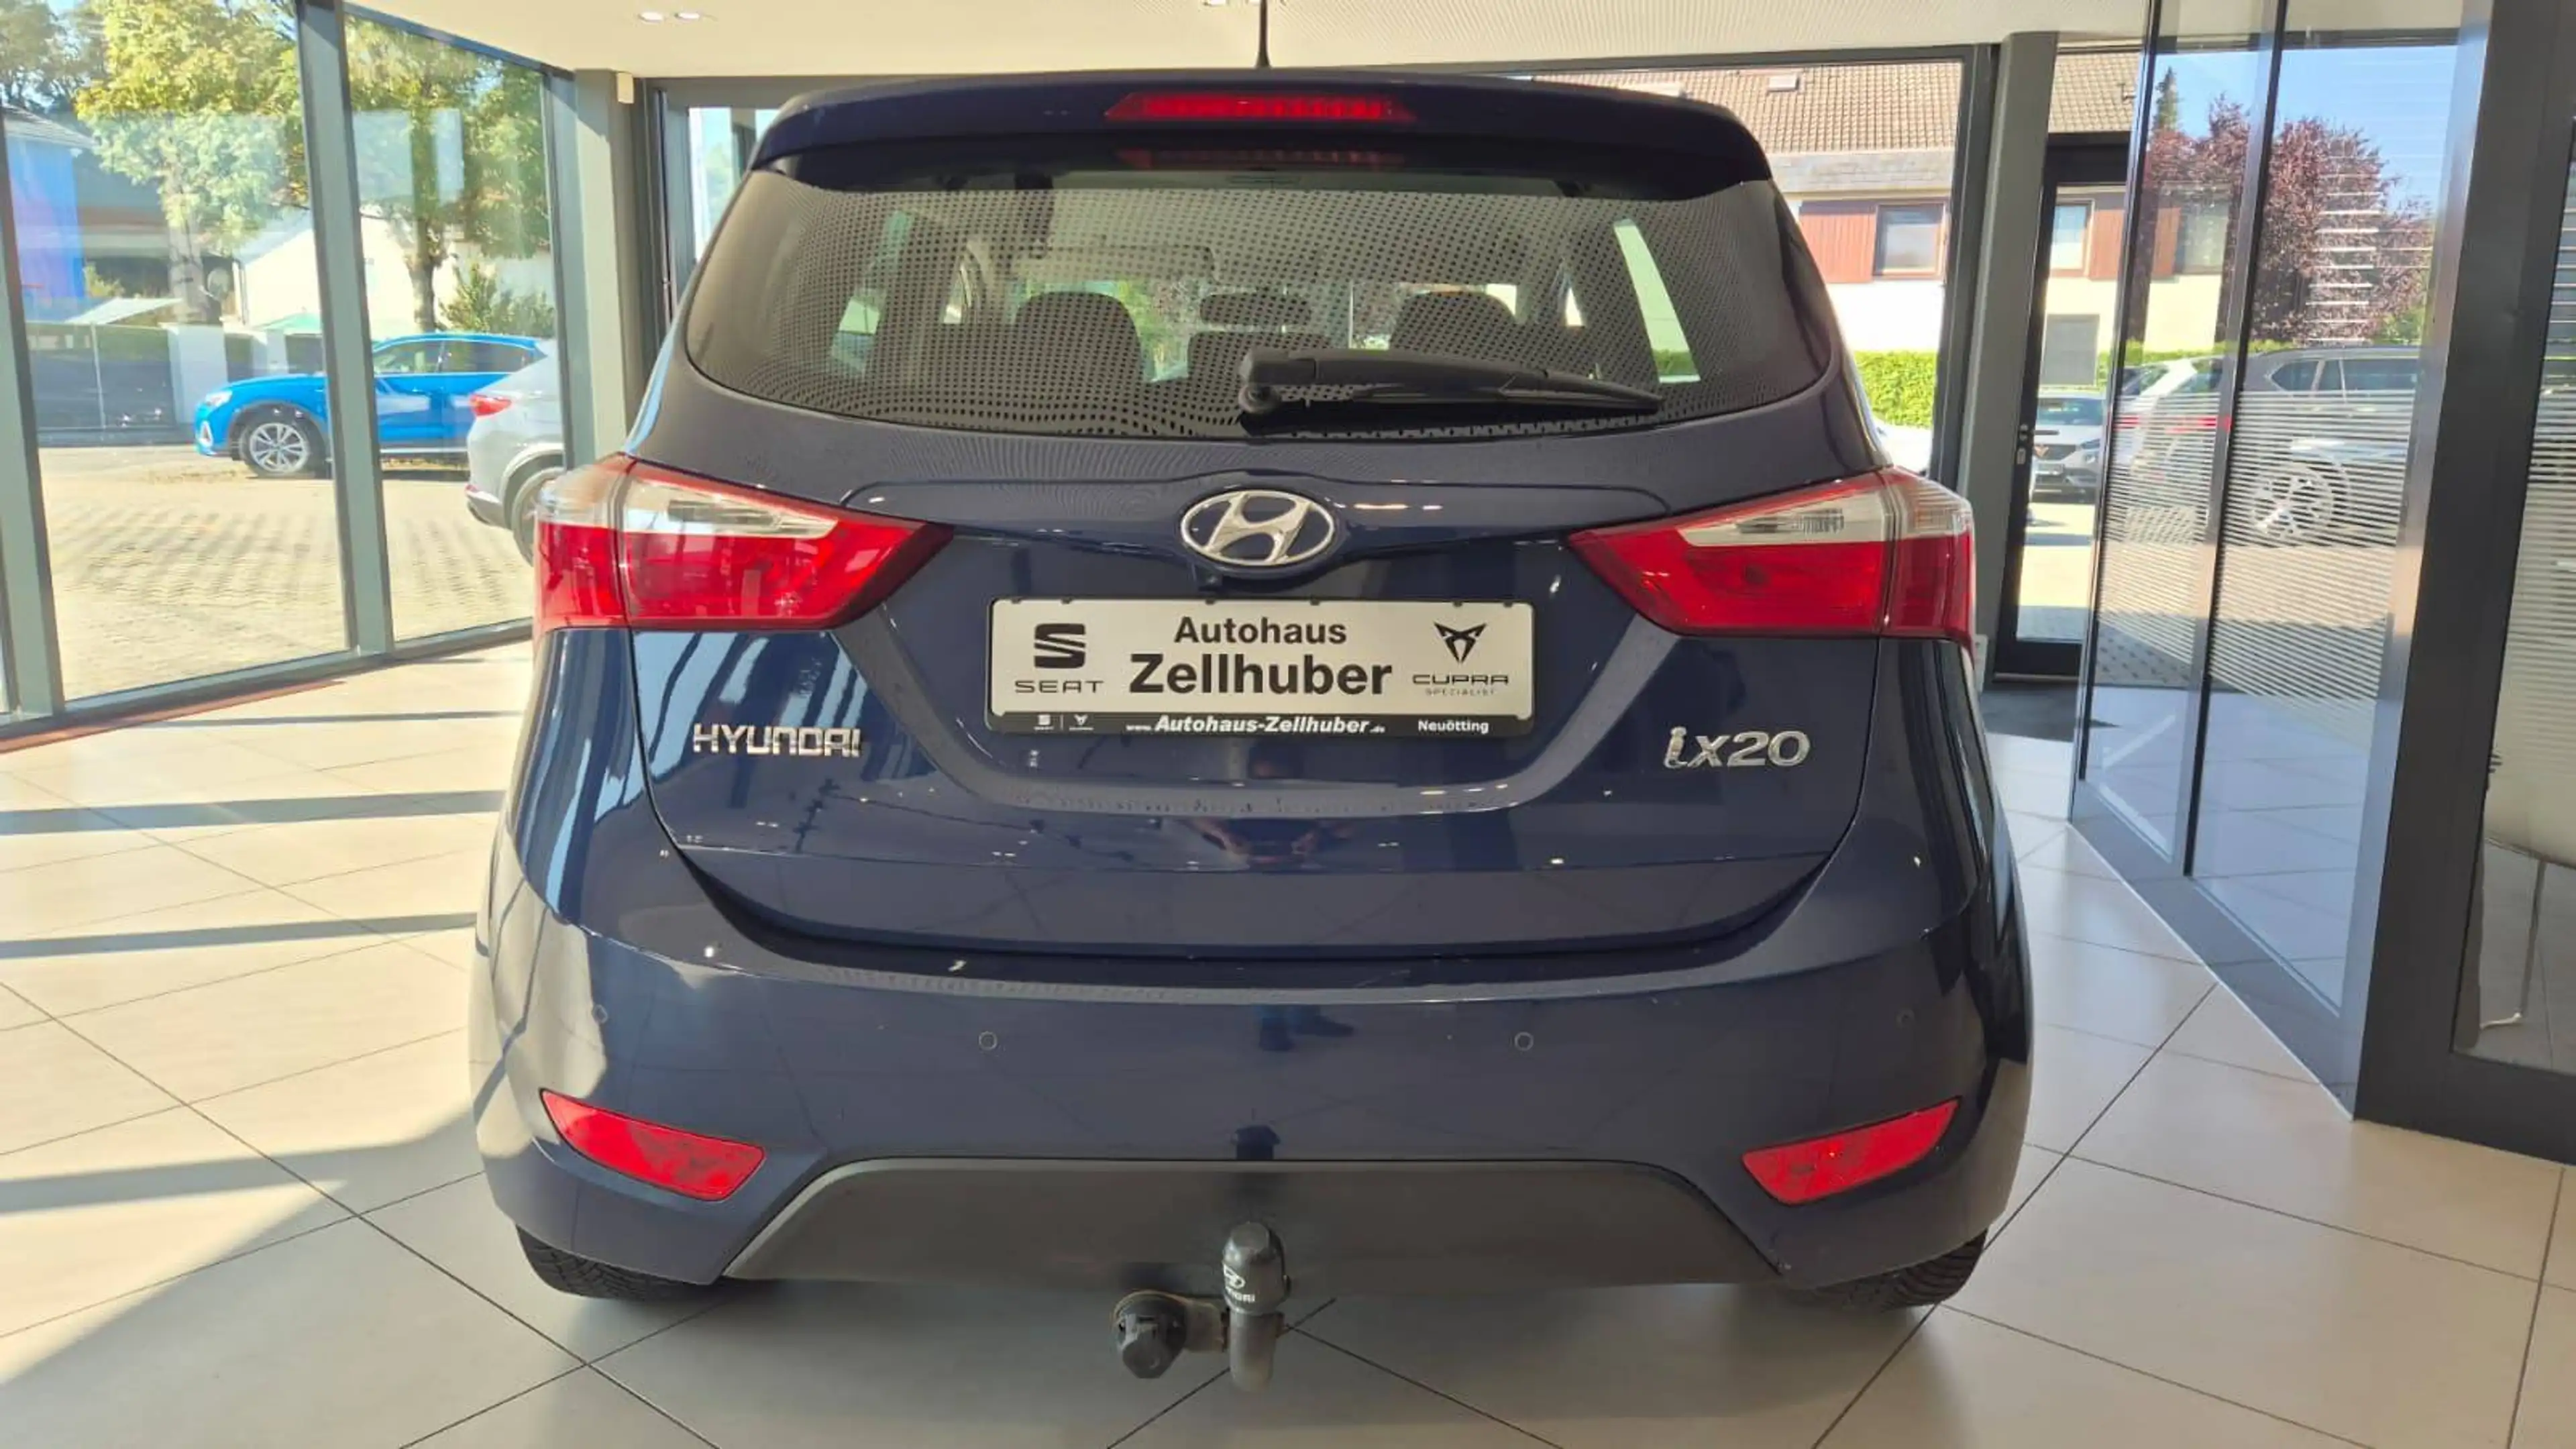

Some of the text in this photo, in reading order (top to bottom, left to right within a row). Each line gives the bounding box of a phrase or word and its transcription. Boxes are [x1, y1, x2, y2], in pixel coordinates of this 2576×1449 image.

[1173, 616, 1347, 644] Autohaus
[1014, 680, 1104, 694] SEAT
[1129, 653, 1393, 694] Zellhuber
[1412, 674, 1509, 686] CUPRA
[693, 722, 861, 758] HYUNDAI
[1417, 718, 1489, 735] Neuötting
[1664, 726, 1811, 769] ix20
